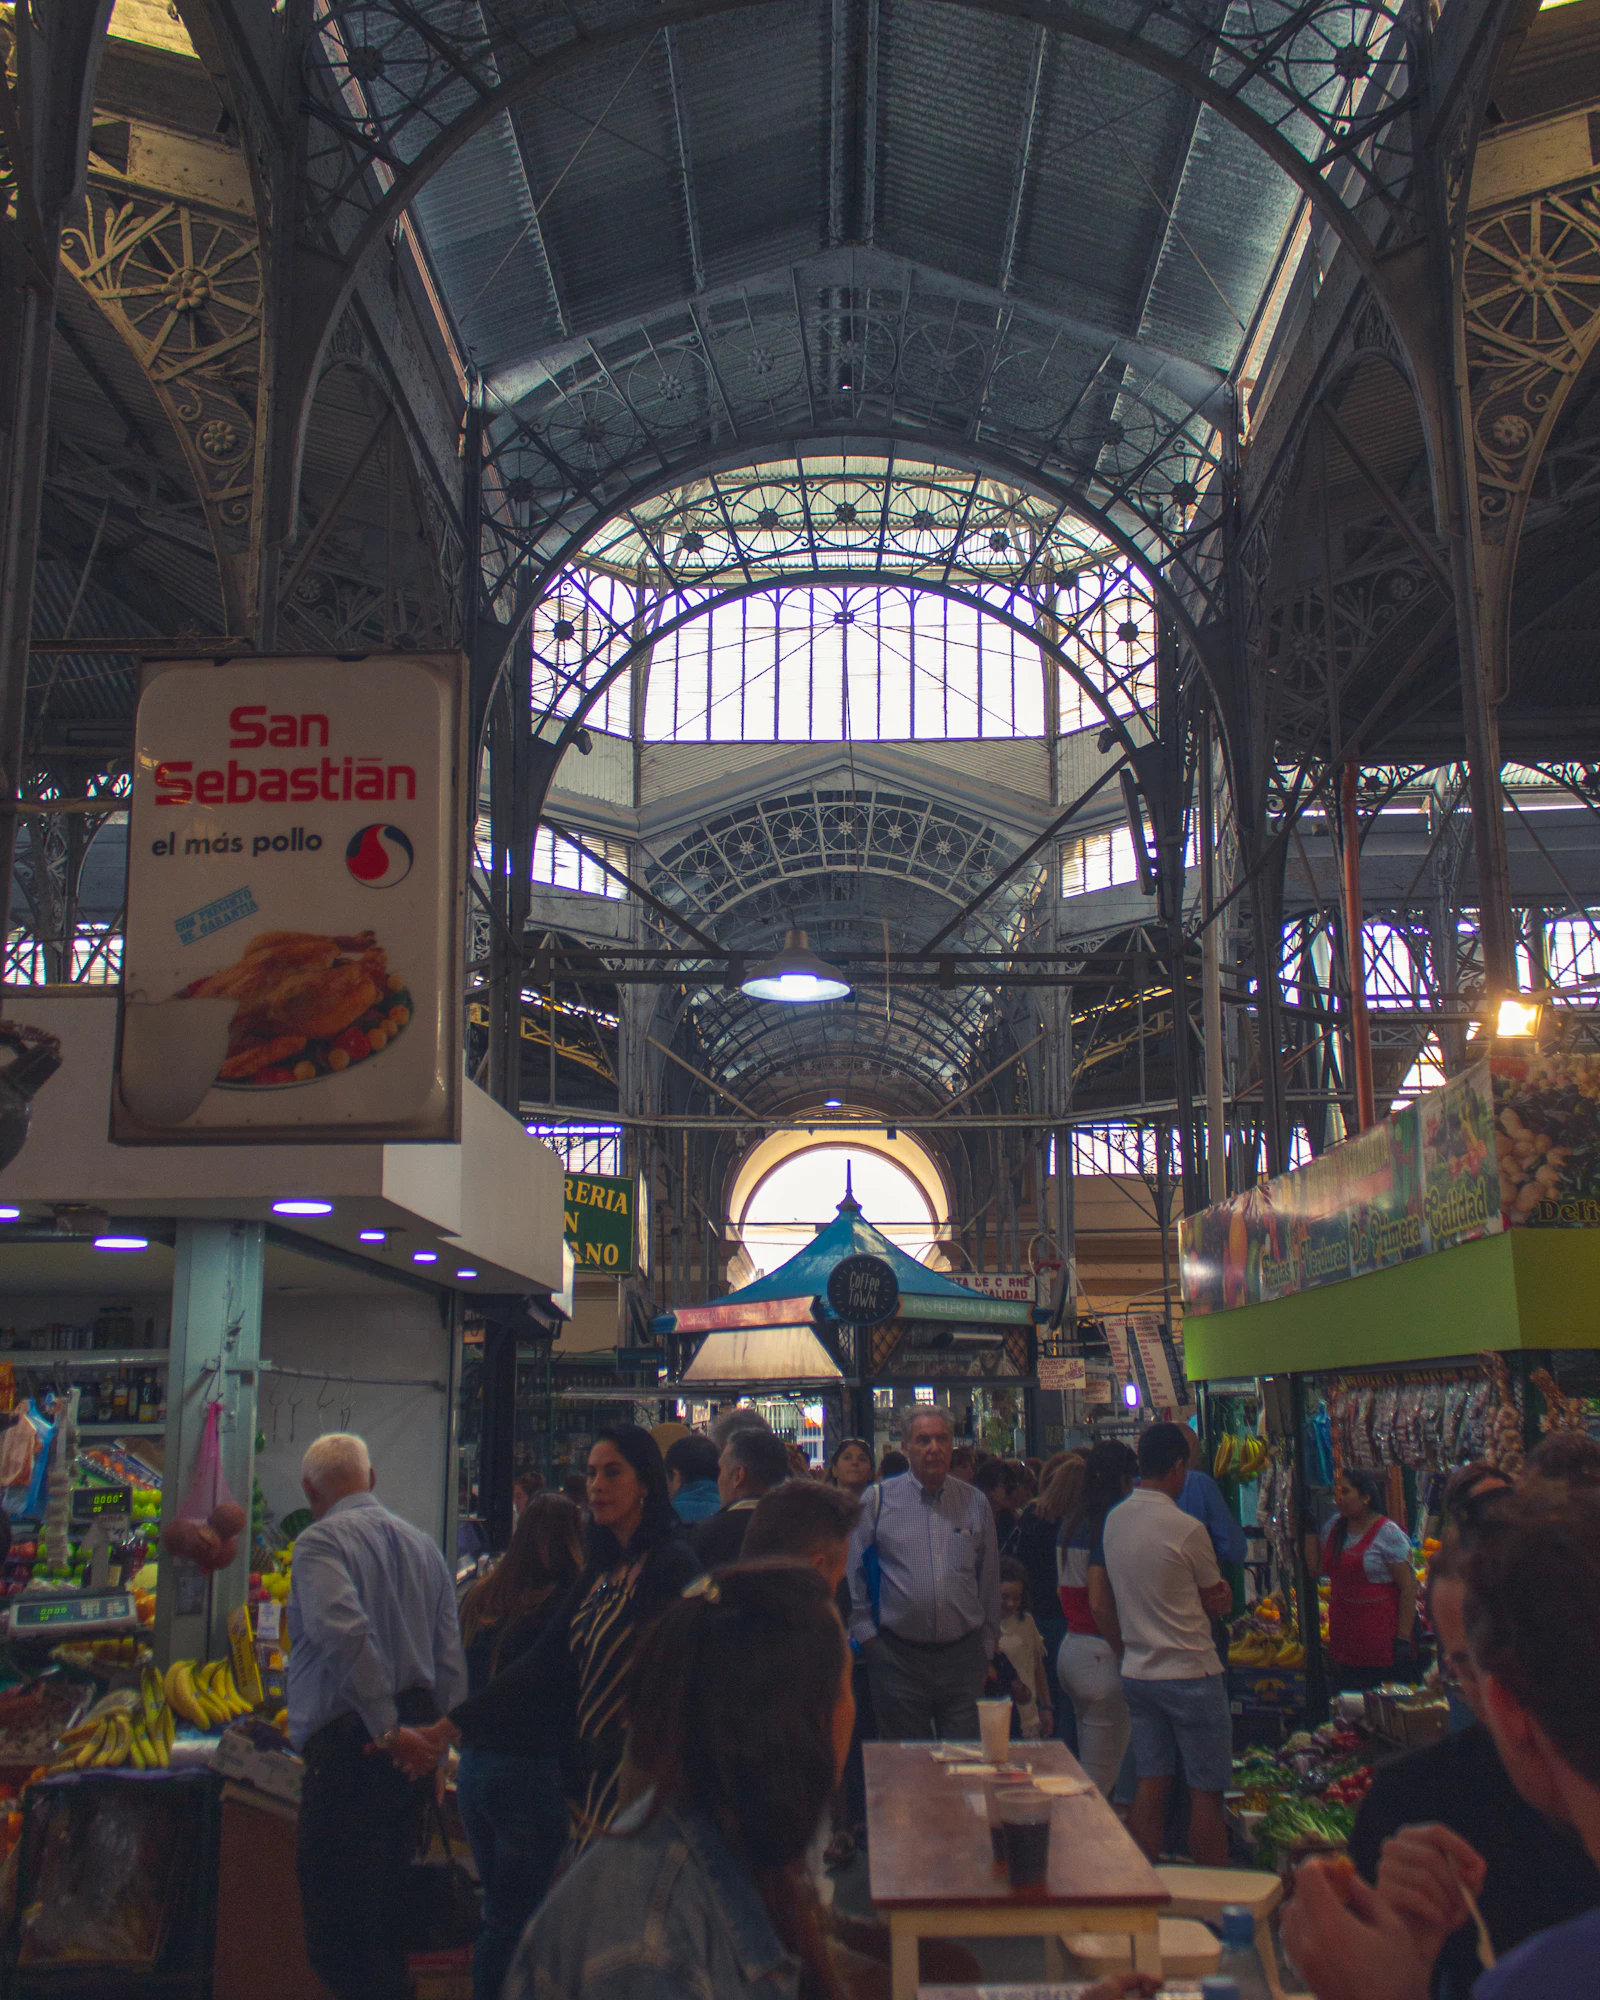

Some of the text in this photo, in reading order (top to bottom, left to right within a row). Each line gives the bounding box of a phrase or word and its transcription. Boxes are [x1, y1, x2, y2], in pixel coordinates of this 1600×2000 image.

[230, 705, 329, 749] San
[152, 827, 323, 858] el más pollo
[198, 889, 252, 921] PRECINTO
[1537, 1197, 1600, 1223] Deli
[975, 1278, 989, 1287] DE
[687, 1309, 729, 1326] SPECIALTY
